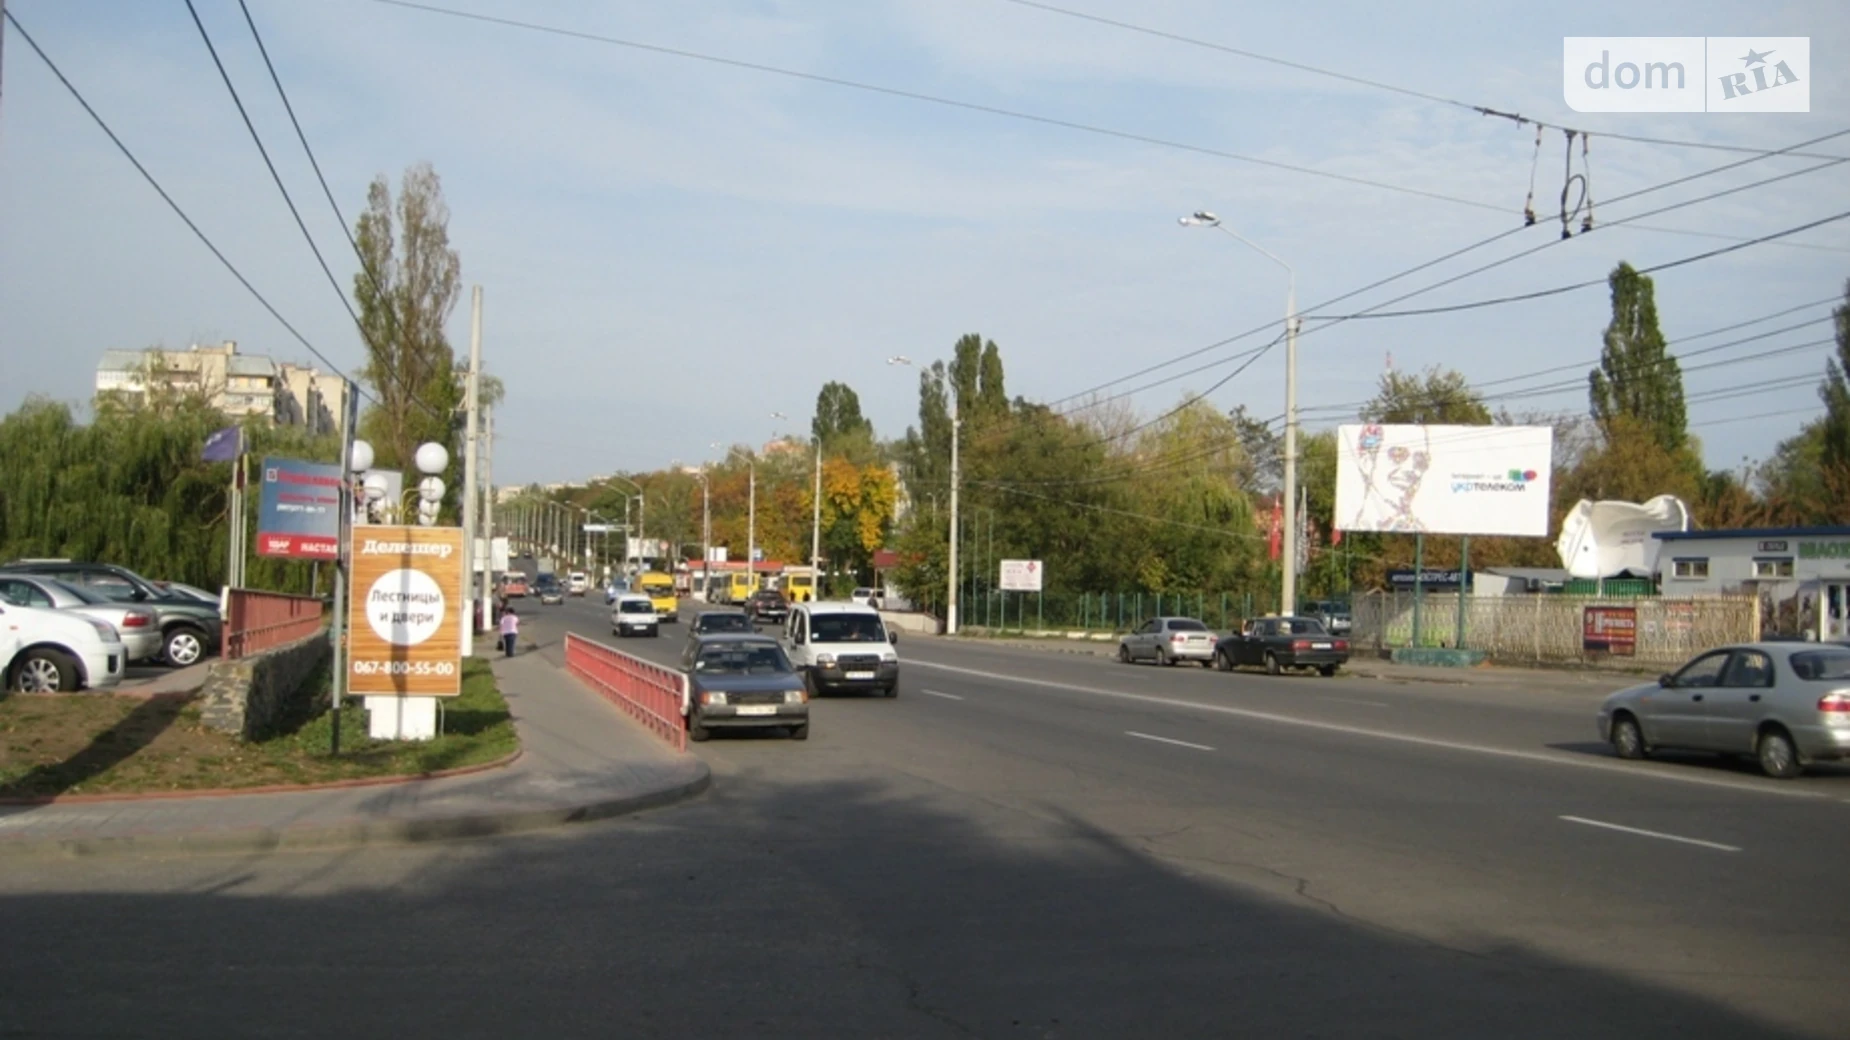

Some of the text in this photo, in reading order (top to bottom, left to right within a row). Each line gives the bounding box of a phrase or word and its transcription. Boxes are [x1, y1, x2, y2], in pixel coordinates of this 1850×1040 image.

[362, 539, 453, 558] Делешер
[371, 590, 440, 604] Лестницы
[379, 612, 434, 626] и двери
[354, 661, 454, 675] 067-800-55-00
